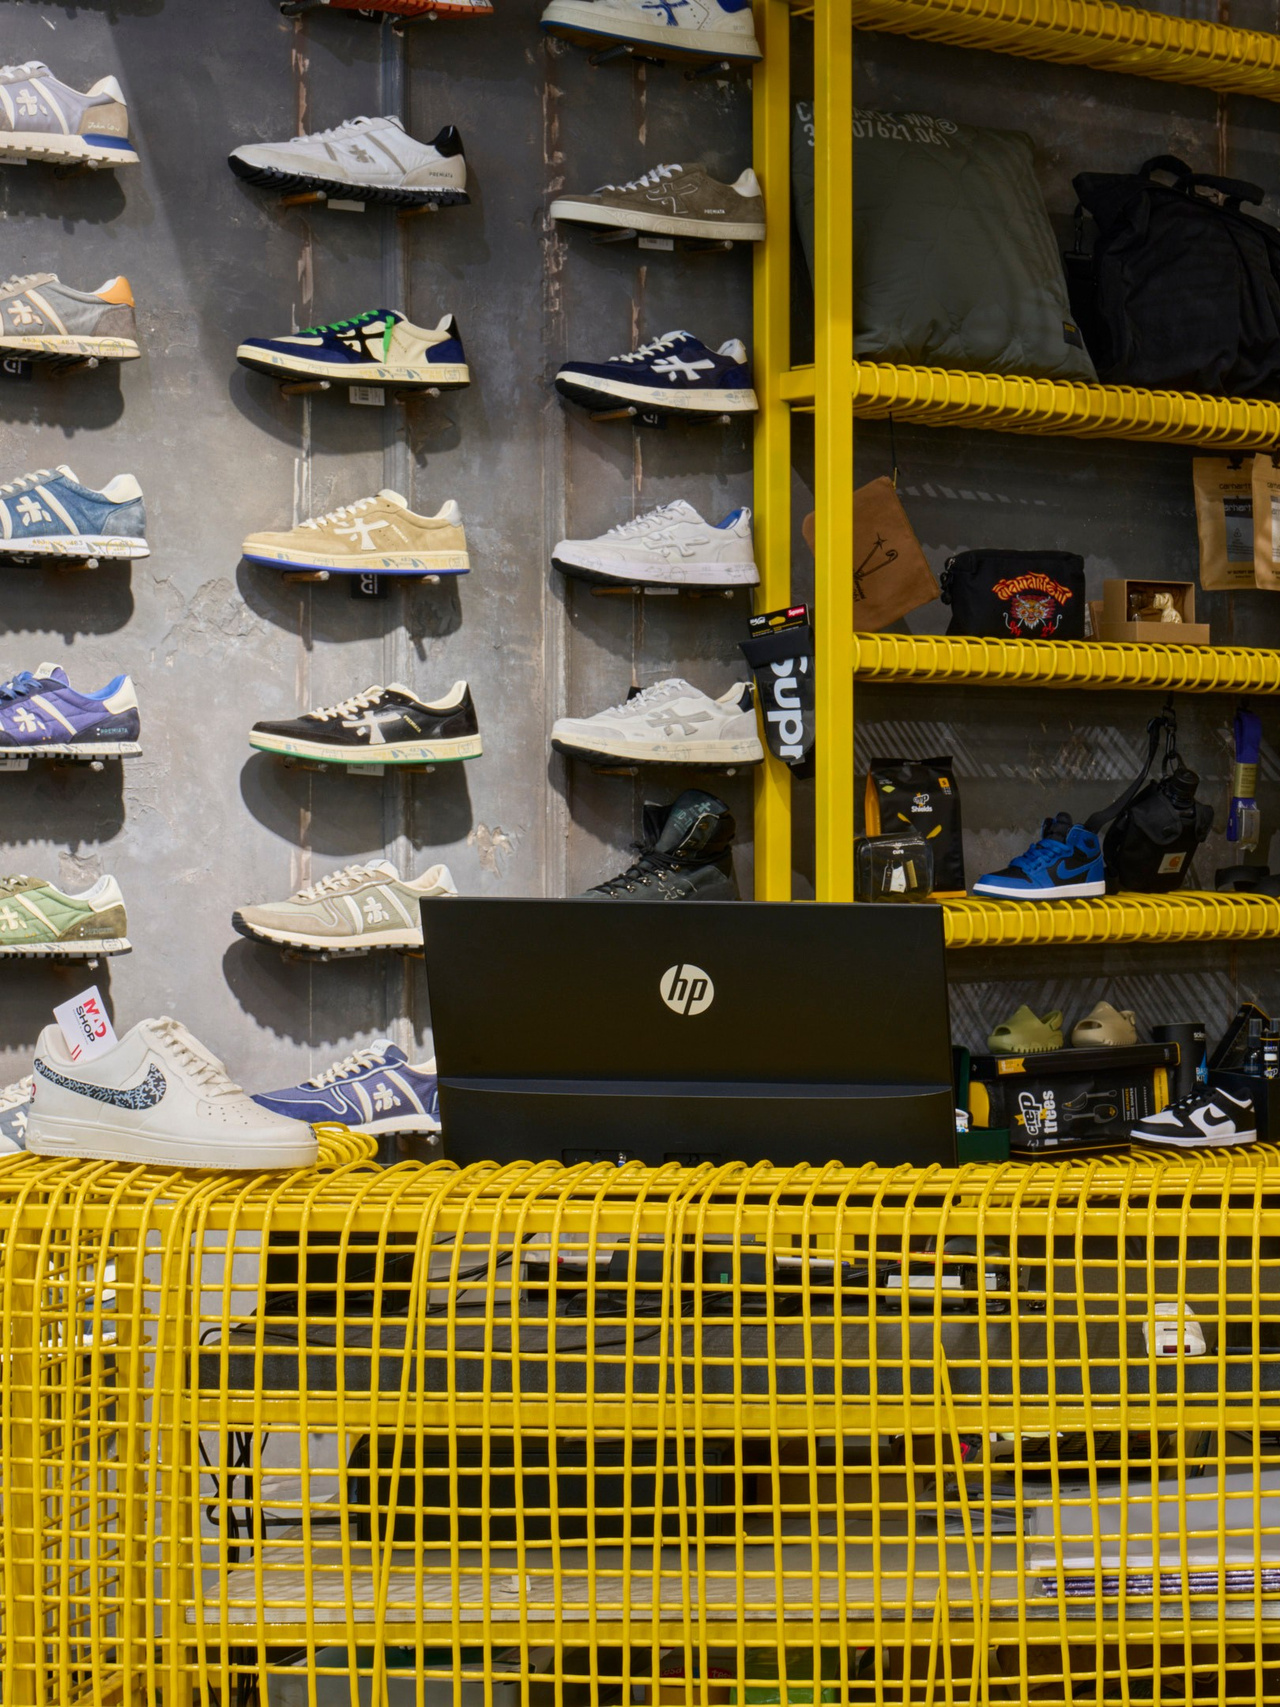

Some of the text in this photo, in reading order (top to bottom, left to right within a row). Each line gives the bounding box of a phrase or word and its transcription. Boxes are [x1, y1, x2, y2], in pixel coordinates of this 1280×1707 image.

[664, 964, 711, 1015] hp
[76, 1005, 96, 1043] SHOP
[1019, 1092, 1043, 1135] crep
[1042, 1090, 1058, 1134] trees
